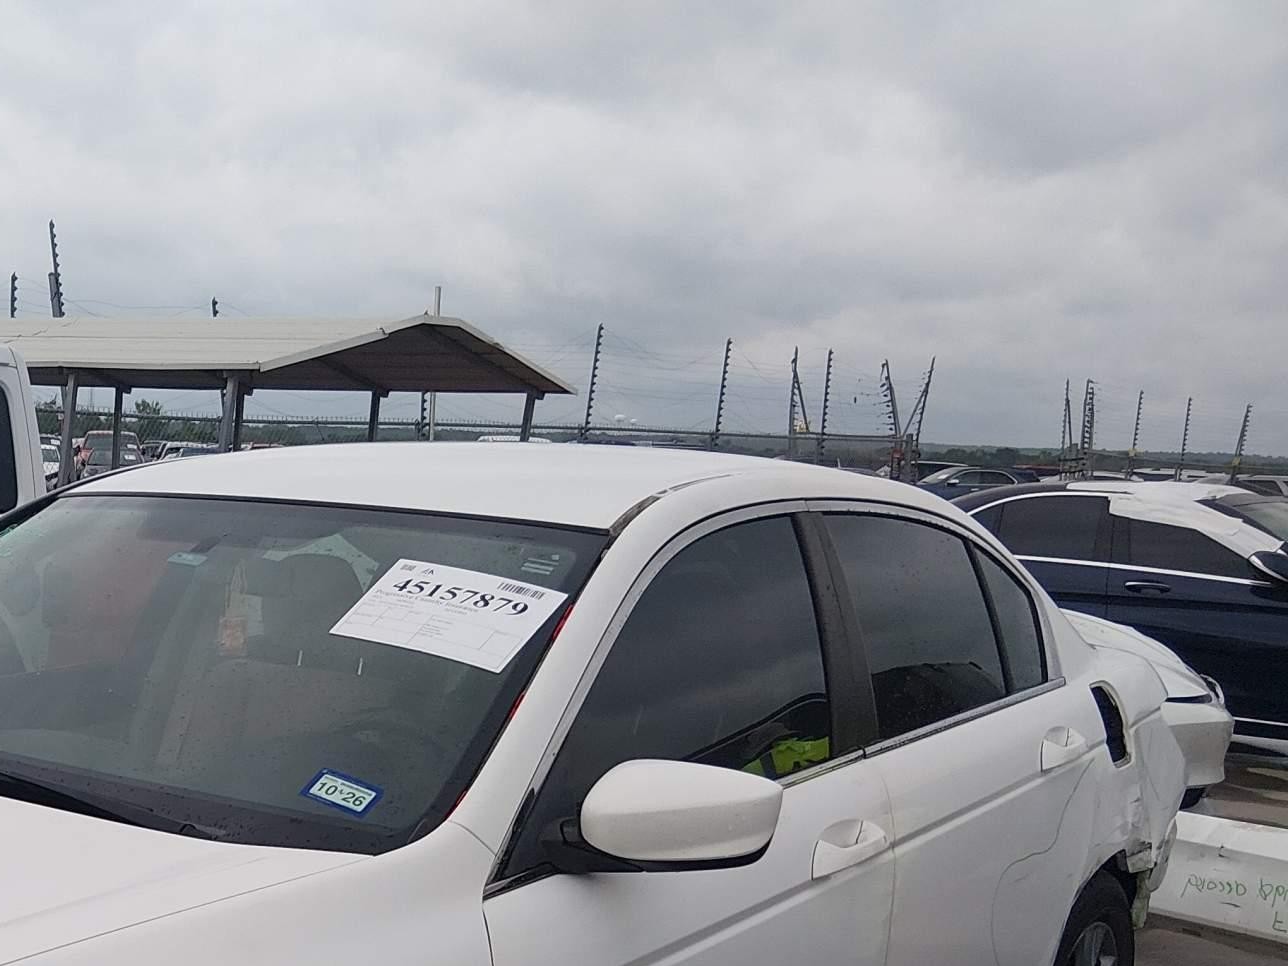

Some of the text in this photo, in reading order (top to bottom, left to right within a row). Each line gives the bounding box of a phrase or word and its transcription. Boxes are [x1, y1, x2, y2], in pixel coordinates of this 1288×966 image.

[392, 578, 529, 616] 45157879
[316, 781, 339, 796] 10
[340, 791, 367, 807] 26
